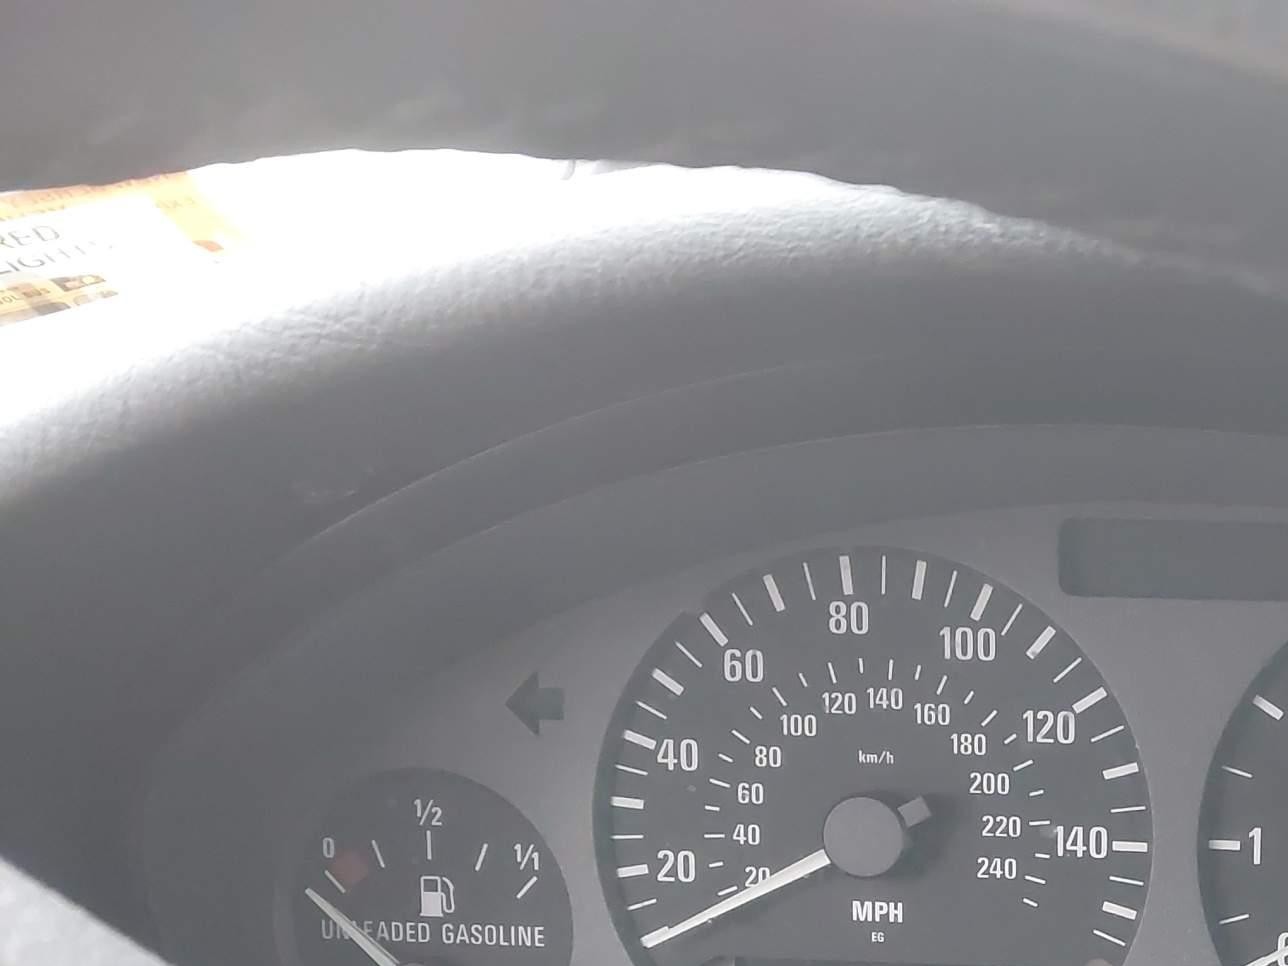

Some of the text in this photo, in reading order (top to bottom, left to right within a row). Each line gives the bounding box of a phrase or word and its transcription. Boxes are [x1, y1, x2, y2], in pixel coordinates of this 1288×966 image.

[828, 600, 869, 635] 80
[939, 626, 996, 661] 100
[723, 648, 764, 683] 60
[822, 692, 857, 715] 120
[866, 687, 903, 710] 140
[780, 714, 817, 737] 100
[913, 702, 951, 726] 160
[1022, 710, 1075, 744] 120
[656, 738, 699, 772] 40
[950, 733, 986, 756] 180
[755, 745, 782, 768] 80
[858, 749, 894, 764] km/h
[737, 782, 764, 805] 60
[969, 772, 1010, 795] 200
[732, 823, 761, 846] 40
[981, 815, 1021, 838] 220
[322, 837, 335, 859] 0
[1053, 825, 1108, 859] 140
[1248, 827, 1262, 865] 1
[657, 849, 696, 883] 20
[744, 866, 771, 889] 20
[976, 857, 1017, 880] 240
[852, 900, 903, 923] MPH
[442, 923, 545, 947] GASOLINE
[871, 931, 885, 943] EG
